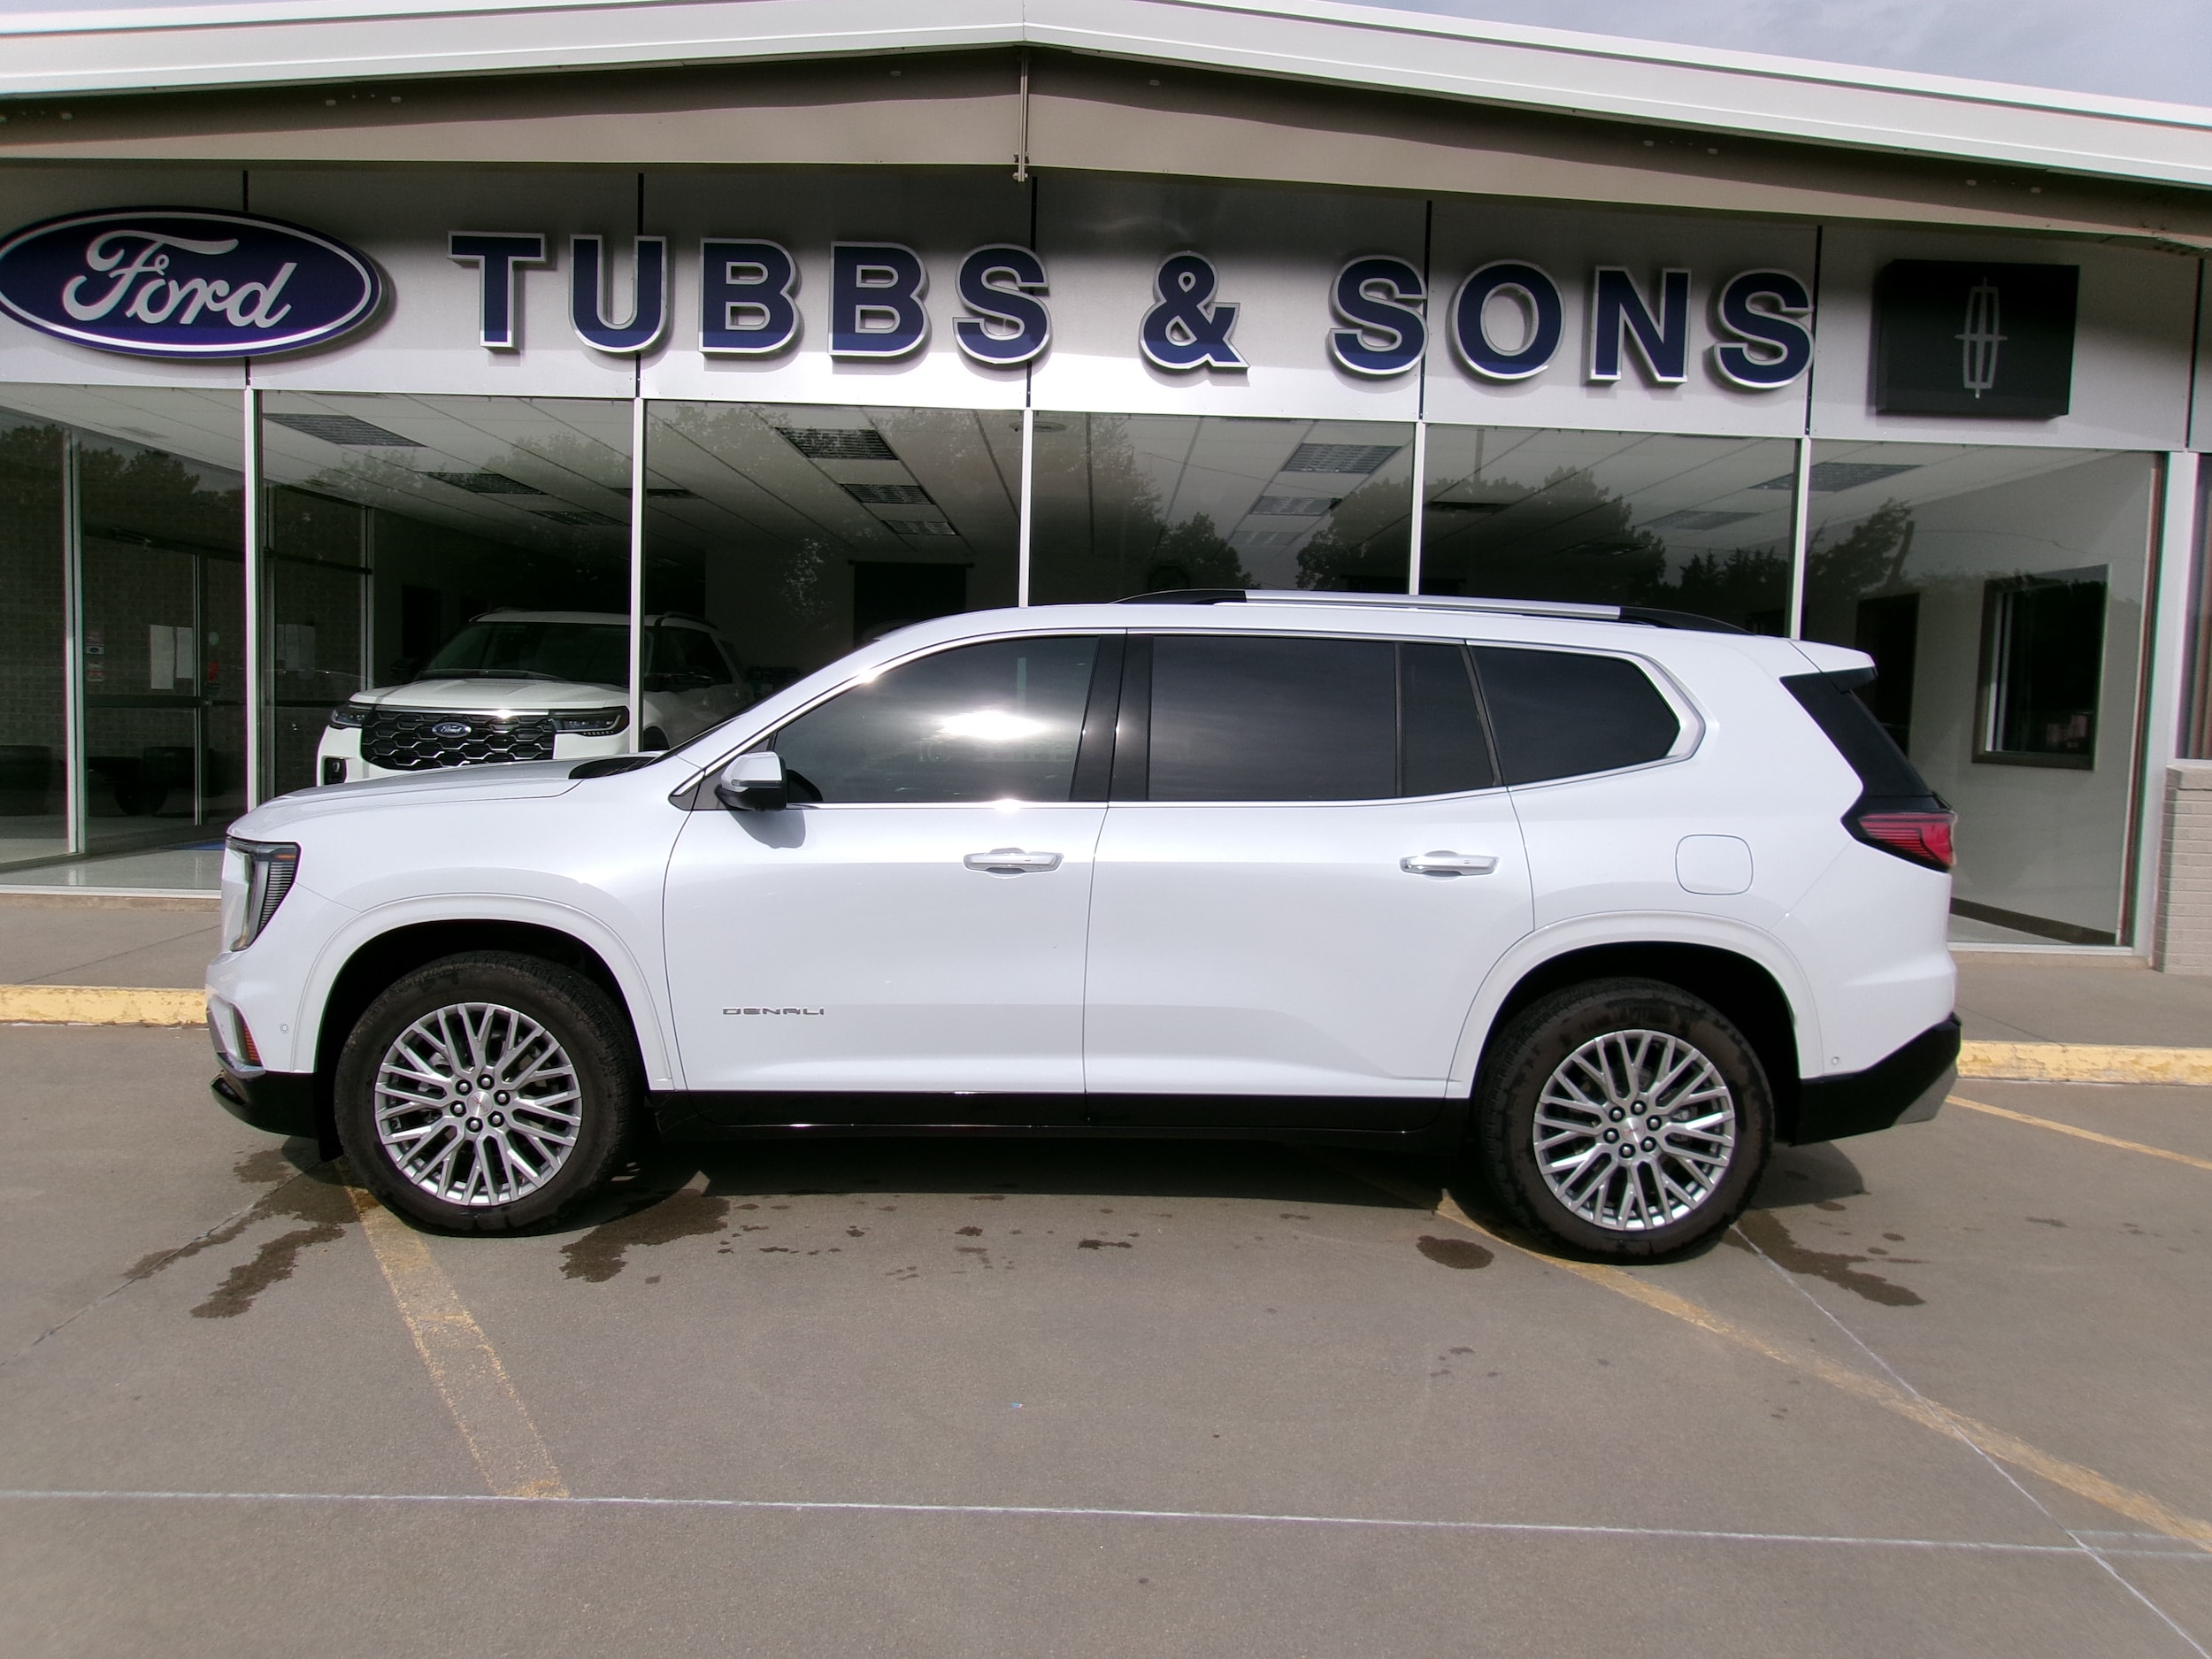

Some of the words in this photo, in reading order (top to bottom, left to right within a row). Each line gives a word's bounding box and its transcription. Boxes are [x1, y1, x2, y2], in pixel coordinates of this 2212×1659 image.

[62, 229, 298, 328] Ford
[447, 231, 1051, 365] TUBBS
[1139, 250, 1249, 372] &
[1328, 255, 1815, 391] SONS
